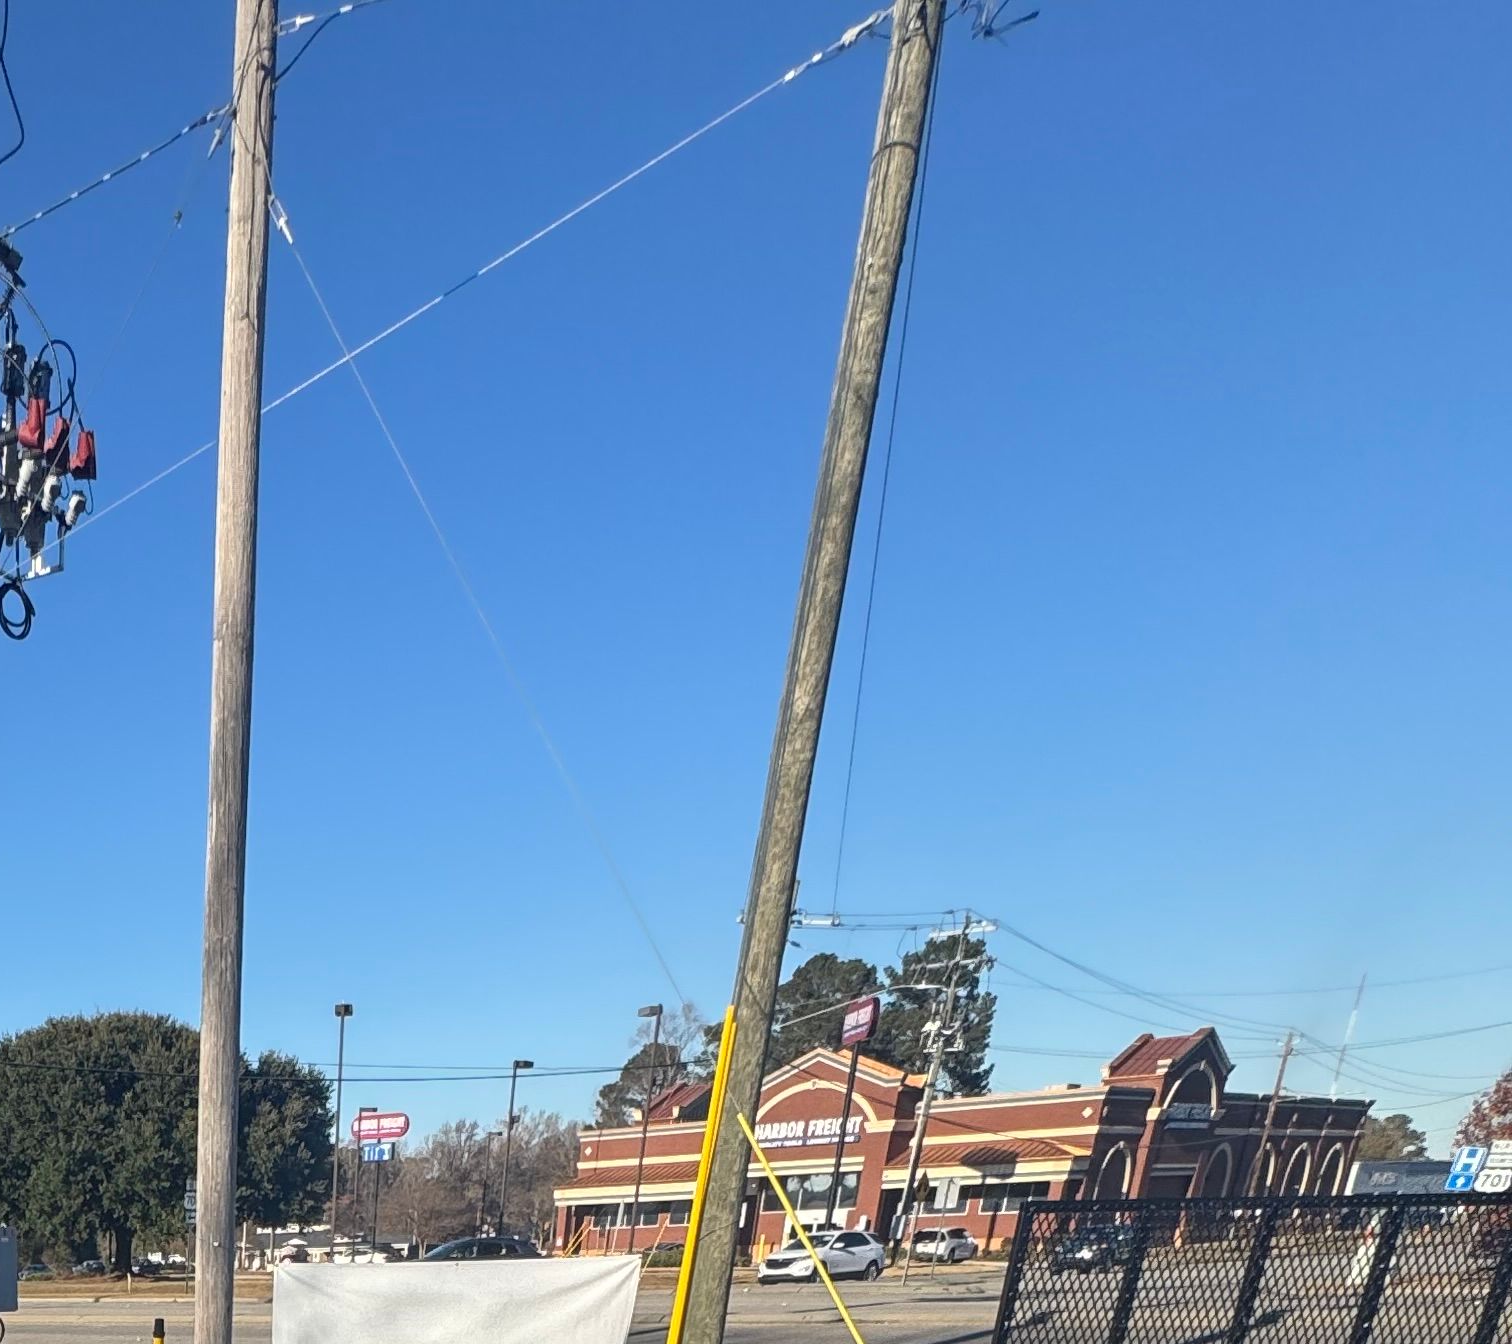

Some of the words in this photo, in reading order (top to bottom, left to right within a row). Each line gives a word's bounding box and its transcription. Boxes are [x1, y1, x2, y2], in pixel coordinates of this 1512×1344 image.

[754, 1120, 806, 1140] HARBOR
[1454, 1148, 1484, 1173] H
[1481, 1174, 1510, 1188] 701
